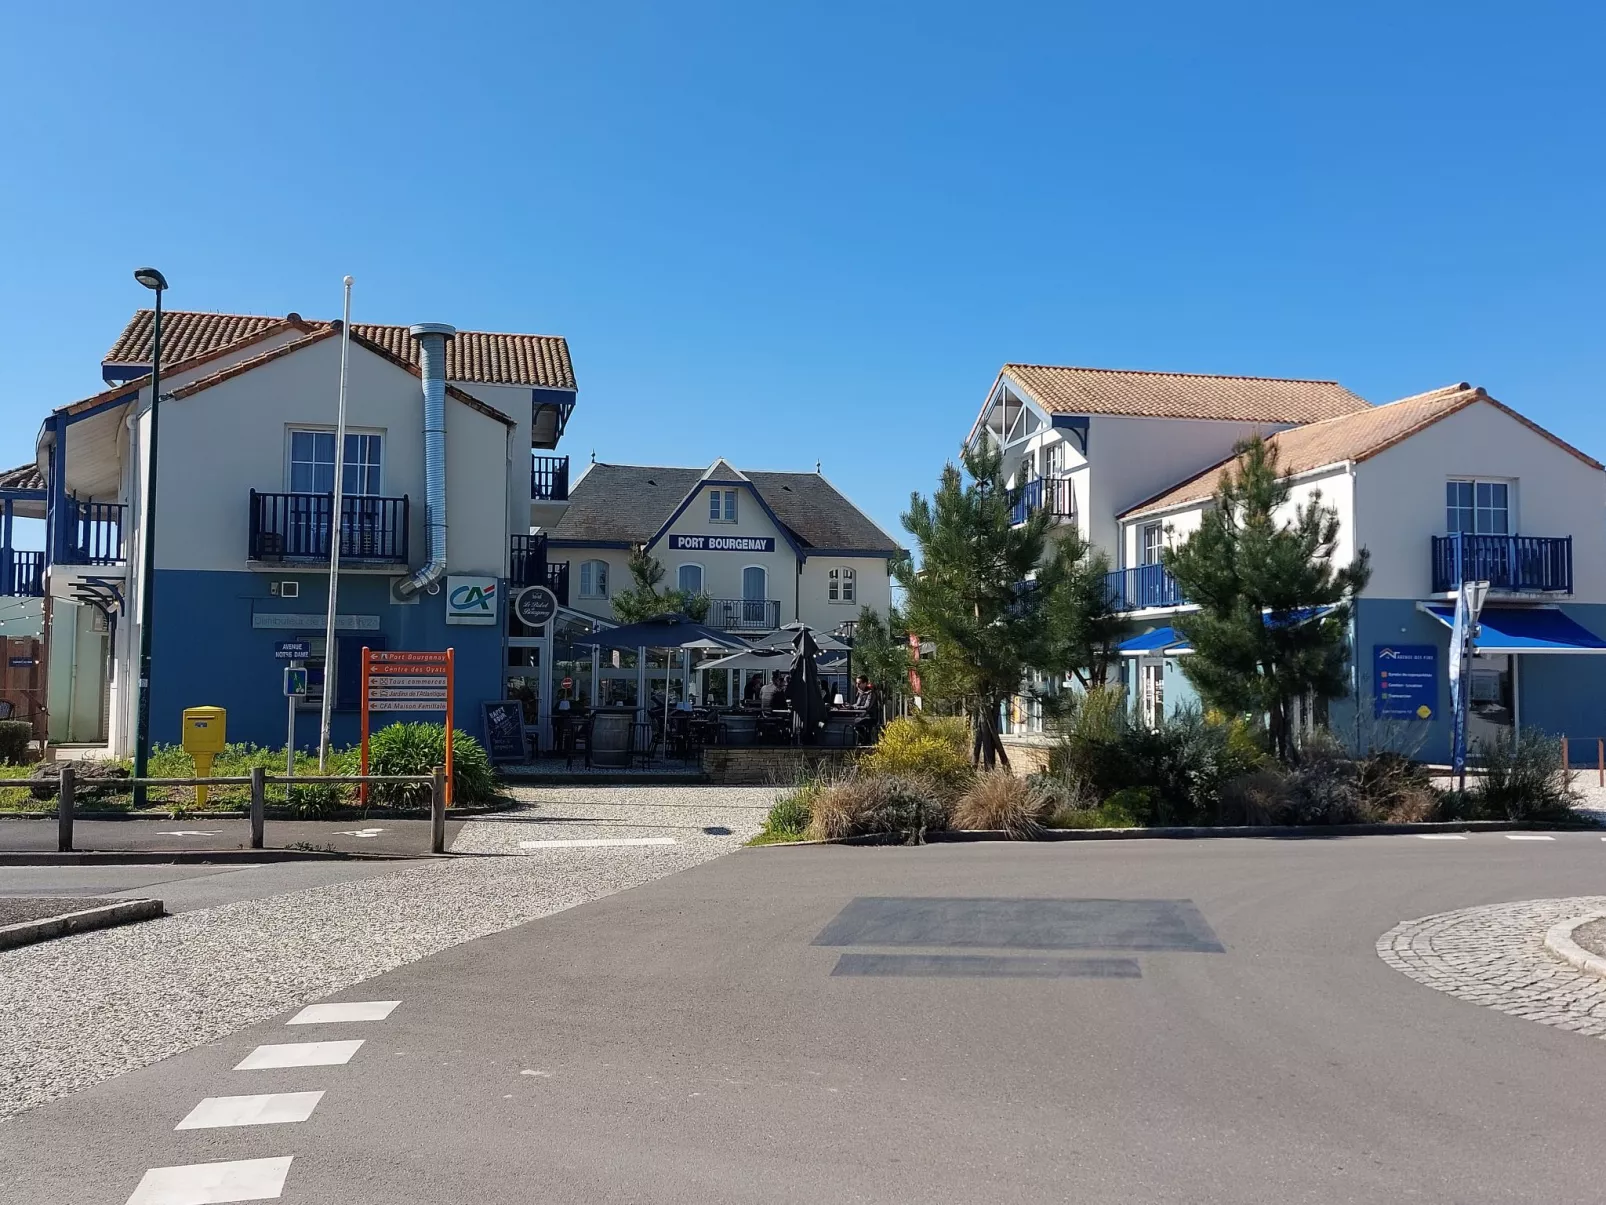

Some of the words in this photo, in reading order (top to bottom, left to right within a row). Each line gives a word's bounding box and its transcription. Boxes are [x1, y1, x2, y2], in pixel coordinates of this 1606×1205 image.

[678, 537, 704, 548] PORT
[709, 538, 767, 550] BOURGENAY
[407, 653, 446, 661] Bourgenay
[384, 664, 408, 673] Centre
[410, 664, 423, 673] des
[425, 665, 446, 674] Oyats
